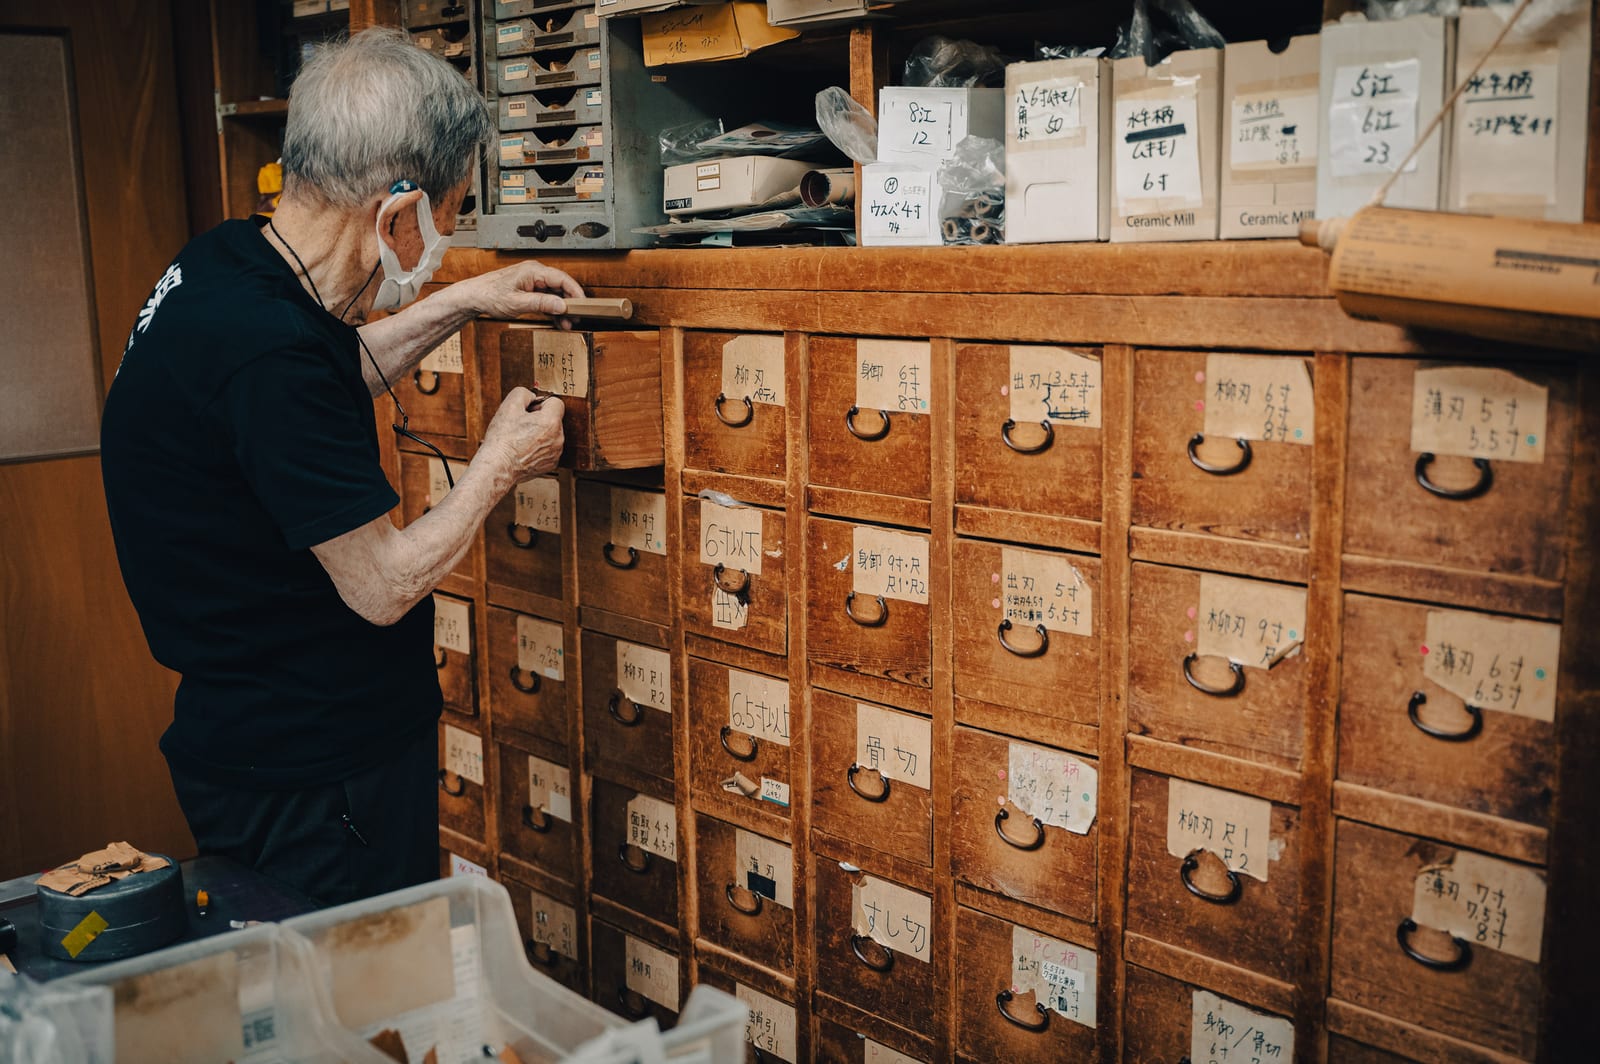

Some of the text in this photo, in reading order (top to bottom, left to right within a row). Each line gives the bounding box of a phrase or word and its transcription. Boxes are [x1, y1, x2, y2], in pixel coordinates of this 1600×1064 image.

[1351, 68, 1400, 97] 5江
[909, 102, 936, 123] 8江
[1362, 106, 1400, 133] 6江
[1045, 115, 1064, 134] 50
[912, 131, 933, 145] 12
[1364, 141, 1390, 164] 23
[1143, 172, 1167, 191] 6寸
[870, 200, 921, 219] ウスバ 4寸
[1126, 212, 1195, 227] Ceramic Mill
[1239, 210, 1289, 226] Ceramic
[538, 351, 574, 369] 柳刃 6寸
[562, 367, 574, 381] 7寸
[734, 364, 764, 387] 柳刃
[899, 364, 919, 380] 6寸
[1013, 371, 1041, 390] 出刃
[563, 381, 575, 395] 8寸
[899, 379, 920, 396] 7寸
[1215, 379, 1290, 405] 柳刃 6寸
[898, 394, 922, 411] 8寸
[1264, 403, 1290, 421] 7寸
[1481, 395, 1519, 425] 5寸
[1262, 420, 1289, 442] 8寸
[705, 523, 760, 562] 6寸以下
[1007, 572, 1079, 602] 出刃 5寸
[1047, 602, 1081, 625] 5.5寸
[1207, 608, 1284, 643] 柳刃 9寸
[623, 661, 645, 682] 柳刃
[1489, 654, 1524, 682] 6寸
[1475, 680, 1522, 711] 6.5寸
[866, 736, 917, 776] 骨切
[1045, 781, 1072, 803] 6寸
[1044, 806, 1071, 827] 7寸
[1179, 809, 1213, 840] 柳刃
[1476, 883, 1506, 909] 7寸
[865, 901, 926, 953] すし切
[1475, 921, 1507, 949] 8寸
[1210, 1043, 1228, 1060] 6寸
